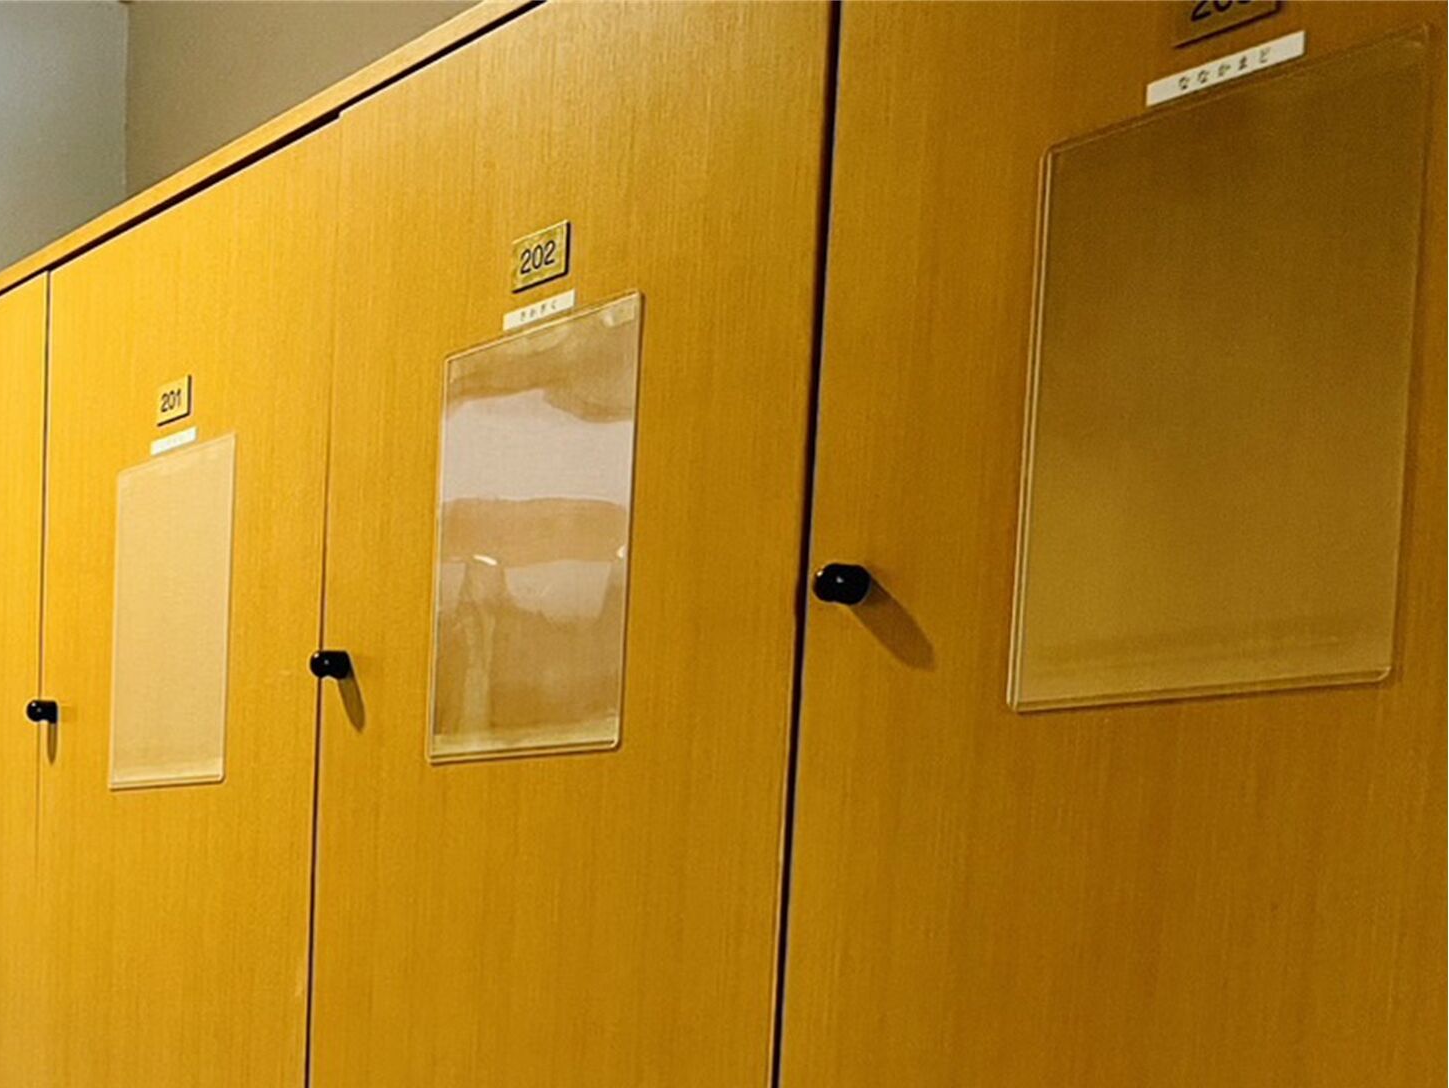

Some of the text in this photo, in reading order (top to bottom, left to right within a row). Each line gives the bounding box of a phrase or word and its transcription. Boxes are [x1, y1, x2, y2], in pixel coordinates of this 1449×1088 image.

[1178, 47, 1271, 90] ななかまど
[520, 240, 556, 274] 202
[161, 388, 181, 412] 201
